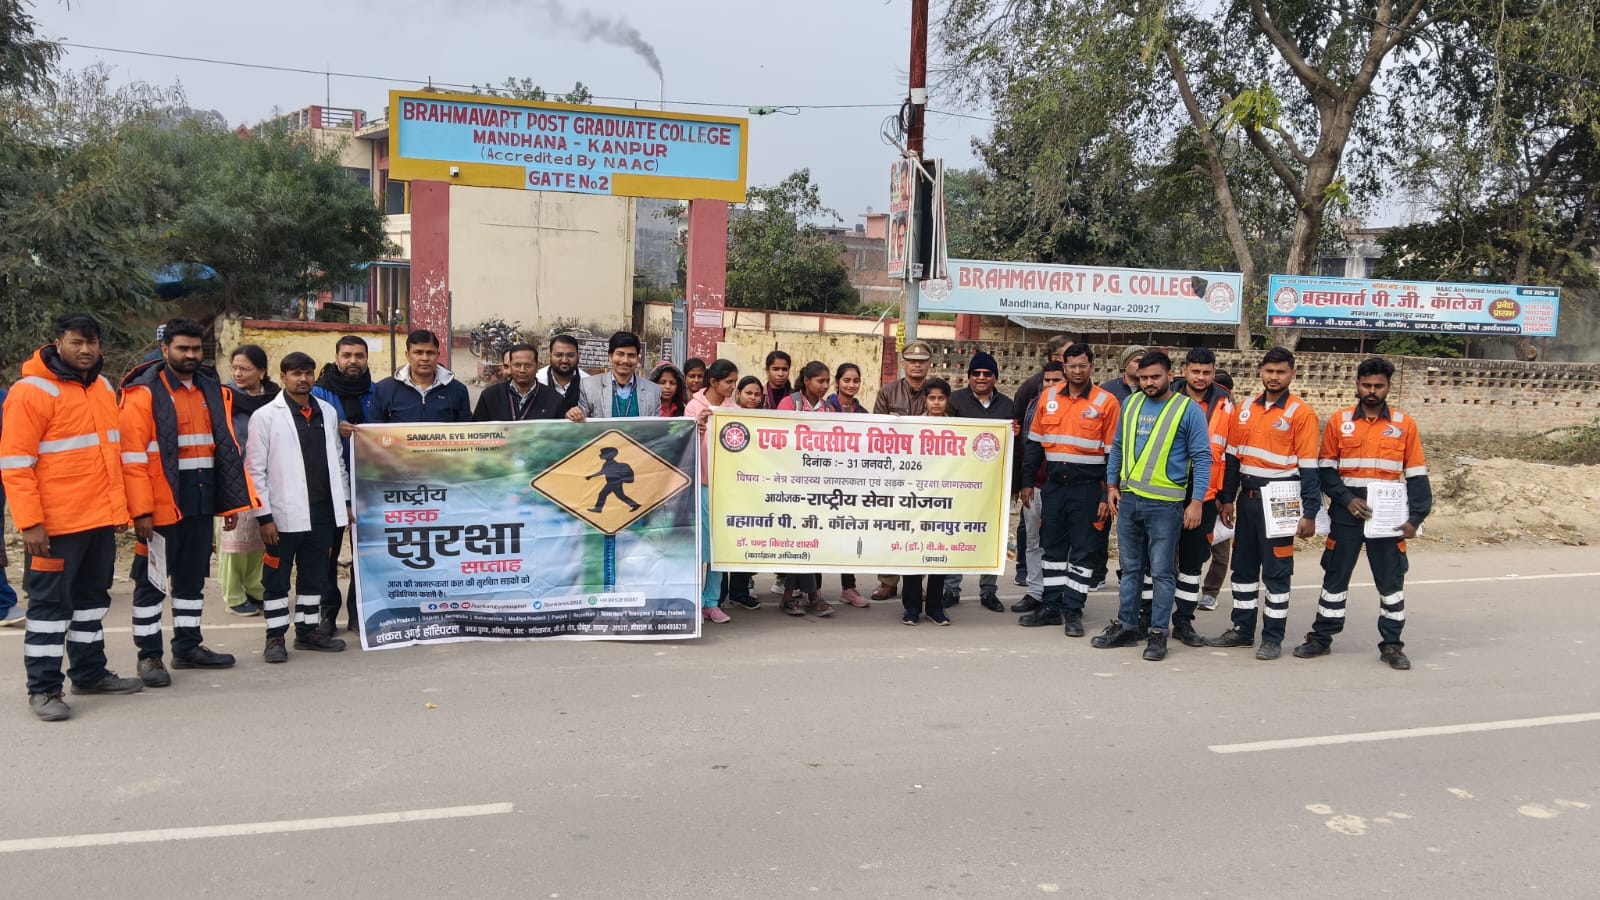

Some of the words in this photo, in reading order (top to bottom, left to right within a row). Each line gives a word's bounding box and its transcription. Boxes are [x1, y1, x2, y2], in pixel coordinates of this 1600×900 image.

[403, 102, 522, 130] BRAHMAVART
[528, 112, 569, 134] POST
[573, 115, 657, 140] GRADUATE
[660, 123, 731, 146] COLLEGE
[473, 130, 567, 151] MANDHANA
[588, 138, 668, 158] KANPUR
[481, 148, 573, 166] (Accredited
[577, 154, 596, 171] By
[603, 156, 659, 173] NAAC)
[528, 171, 576, 189] GATE
[959, 266, 1087, 294] BRAHMAVART
[1092, 273, 1123, 295] P.G.
[1129, 275, 1199, 298] COLLEG
[1453, 287, 1485, 295] Accredited
[1000, 298, 1053, 311] Mandhana,
[1055, 301, 1091, 313] Kanpur
[1093, 302, 1125, 315] Nagar-
[1126, 304, 1160, 314] 209217
[1302, 289, 1367, 306] ब्रह्मावर्त
[1430, 292, 1484, 311] कॉलेज
[1414, 312, 1435, 320] नगर
[406, 433, 446, 441] SANKARA
[467, 431, 505, 440] HOSPITAL
[756, 428, 789, 450] एक
[794, 424, 861, 452] दिवसीय
[866, 427, 913, 455] विशेष
[919, 429, 967, 456] शिविर
[802, 453, 832, 467] दिनांक
[847, 459, 858, 468] 31
[861, 456, 895, 472] जनवरी,
[899, 460, 922, 470] 2026
[736, 470, 759, 482] विषय
[774, 472, 787, 483] नेत्र
[869, 478, 881, 487] एवं
[916, 479, 939, 491] सुरक्षा
[383, 485, 447, 505] राष्ट्रीय
[861, 490, 895, 508] सेवा
[898, 492, 953, 509] योजना
[384, 509, 440, 525] सड़क
[726, 512, 774, 528] ब्रह्मावर्त
[778, 513, 796, 529] पी.
[801, 514, 823, 530] जी.
[828, 515, 869, 530] कॉलेज
[920, 520, 961, 535] कानपुर
[964, 521, 987, 532] नगर
[384, 522, 525, 570] सुरक्षा
[736, 537, 748, 547] डॉ.
[769, 537, 794, 548] किशोर
[891, 541, 902, 551] प्रो.
[905, 541, 924, 552] (डॉ.)
[778, 551, 811, 561] अधिकारी)
[461, 558, 523, 575] सप्ताह
